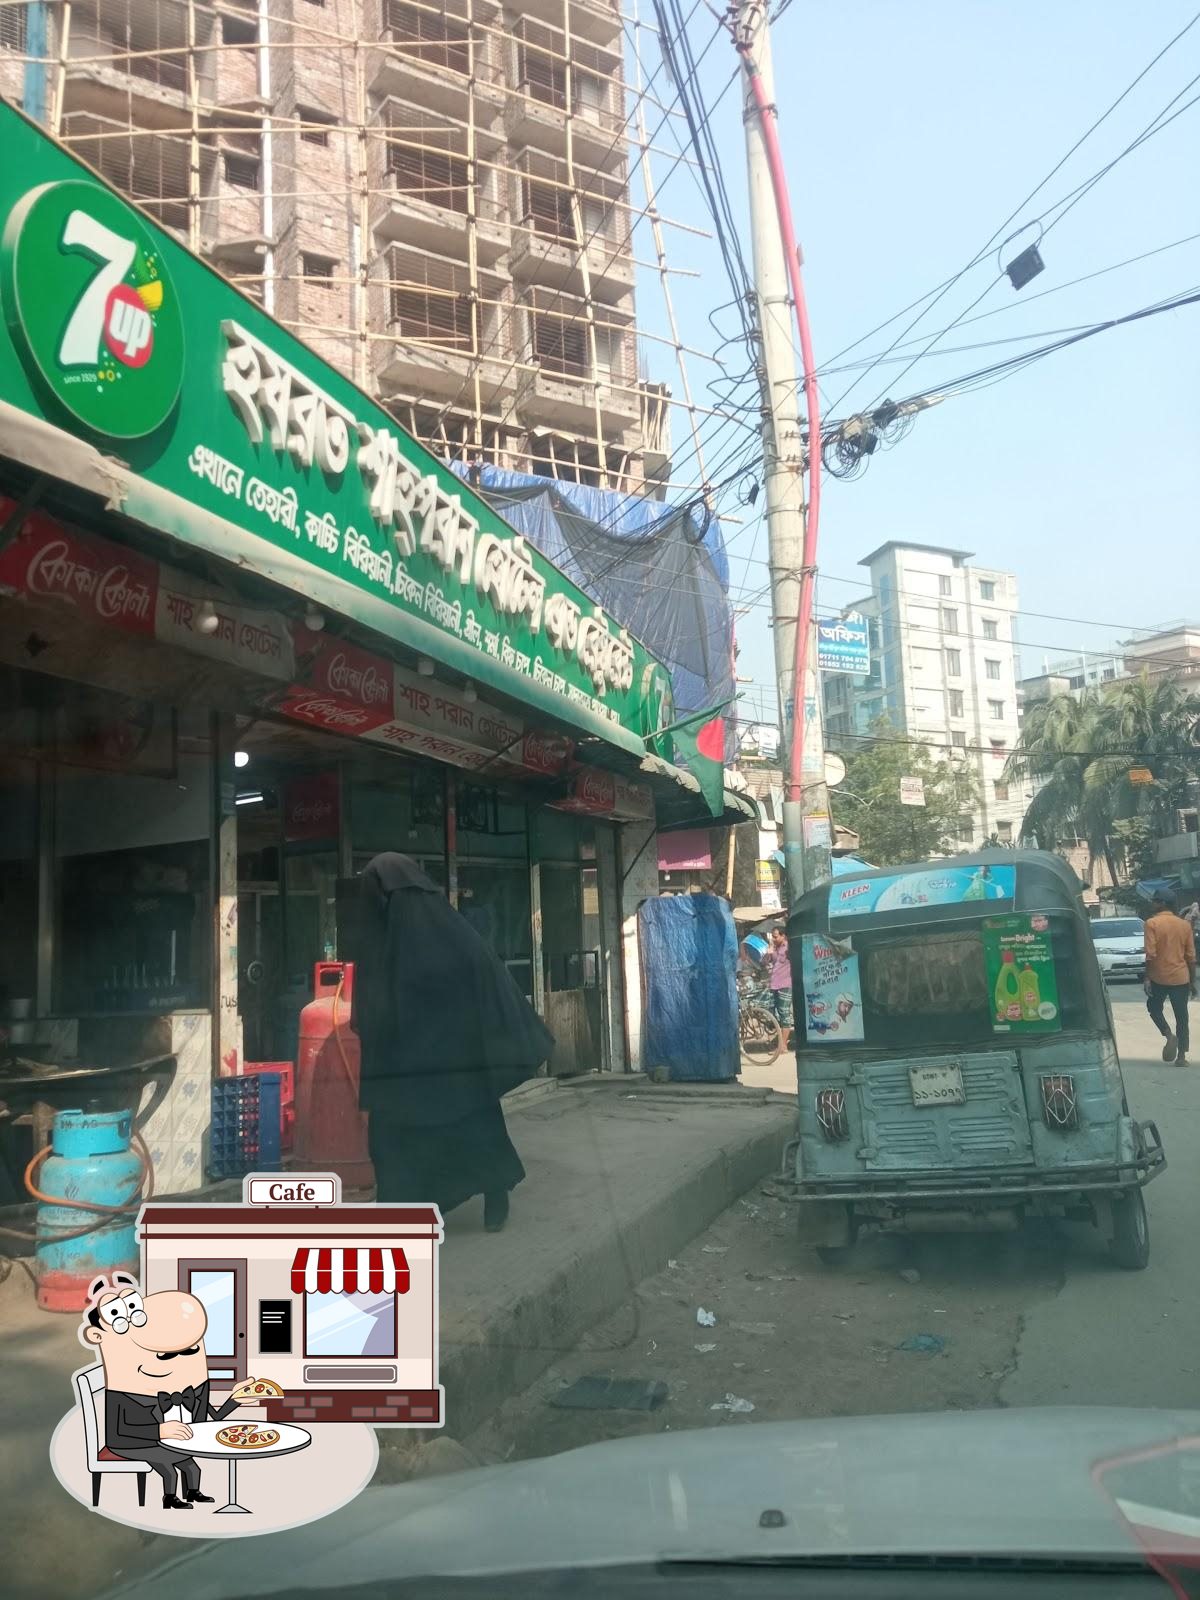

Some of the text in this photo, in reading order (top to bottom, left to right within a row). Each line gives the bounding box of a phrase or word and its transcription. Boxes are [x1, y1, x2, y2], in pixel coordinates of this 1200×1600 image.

[220, 320, 358, 474] হযরত
[474, 533, 546, 634] হোটেল
[188, 444, 245, 499] এখানে
[246, 476, 300, 539] তেহারী,
[305, 510, 340, 554] কাচ্চি
[395, 561, 424, 608] চিকেন
[27, 541, 150, 617] কোকা কোলা
[167, 594, 196, 631] শাহ
[819, 625, 866, 646] অফিস
[399, 686, 432, 718] শাহ
[841, 884, 870, 900] KLEEN
